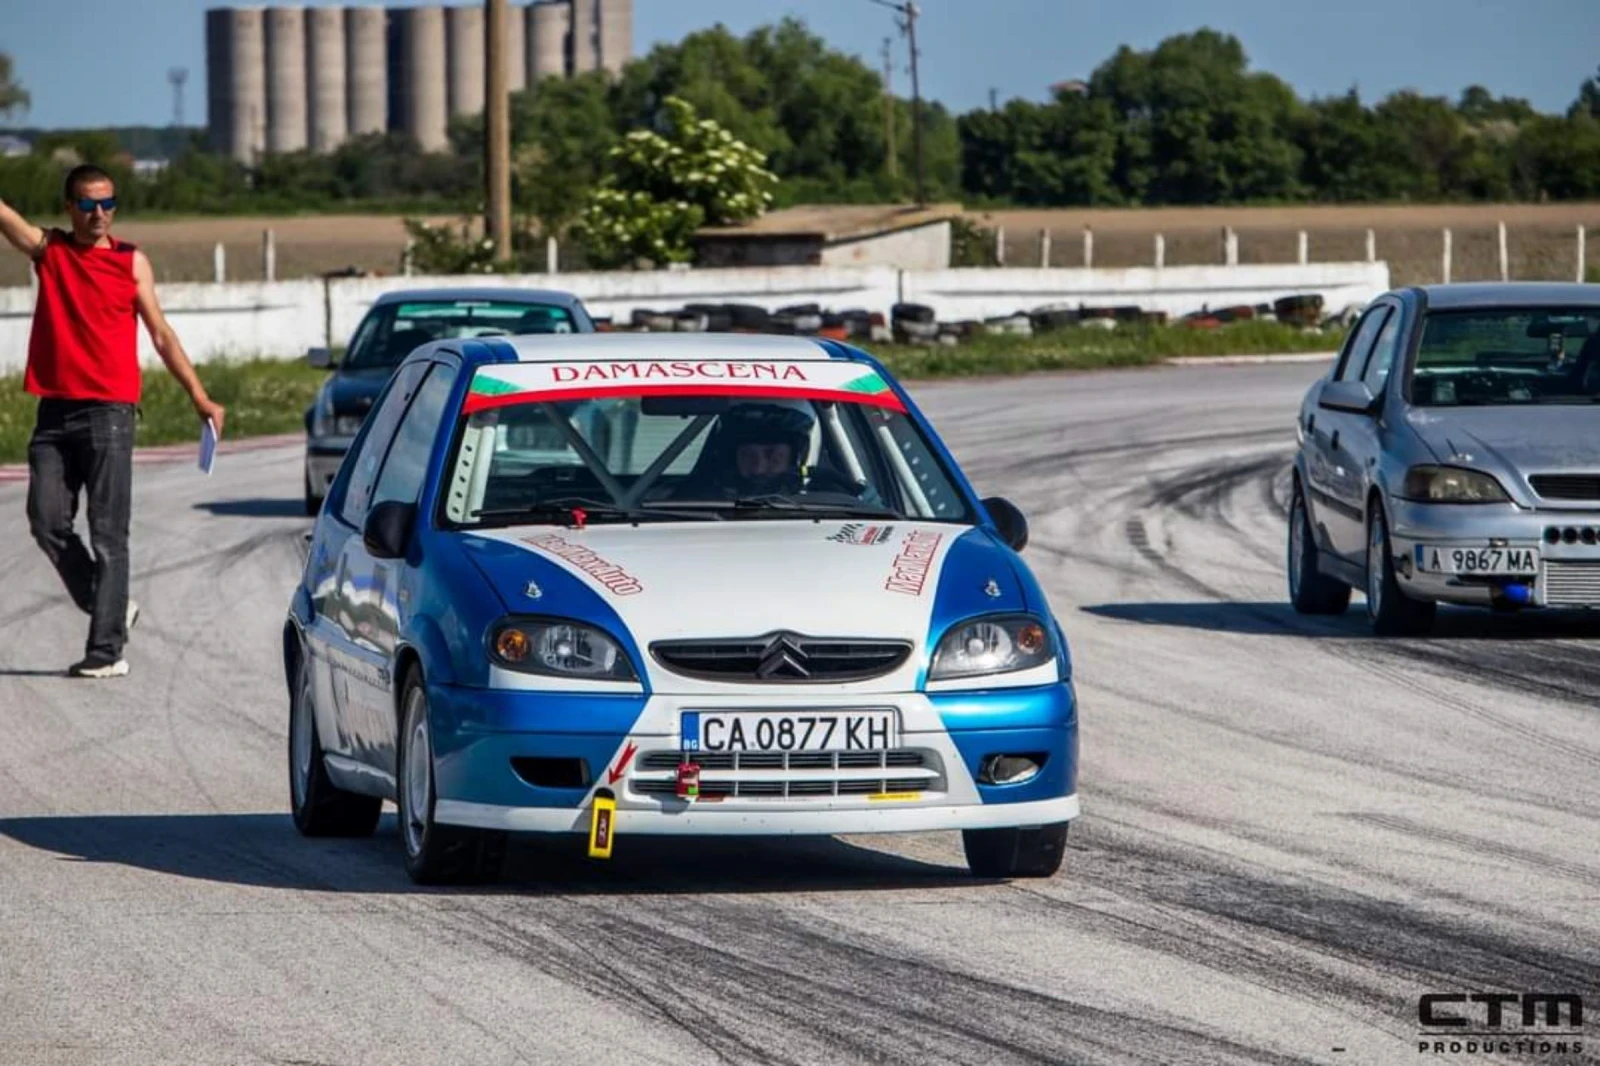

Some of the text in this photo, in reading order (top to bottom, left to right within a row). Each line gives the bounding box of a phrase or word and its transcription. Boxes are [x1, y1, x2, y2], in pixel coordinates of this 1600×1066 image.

[552, 362, 808, 383] DAMASCENA
[1431, 550, 1441, 570] A
[1452, 550, 1503, 570] 9867
[1507, 550, 1535, 570] MA
[703, 716, 888, 751] CA 0877 KH
